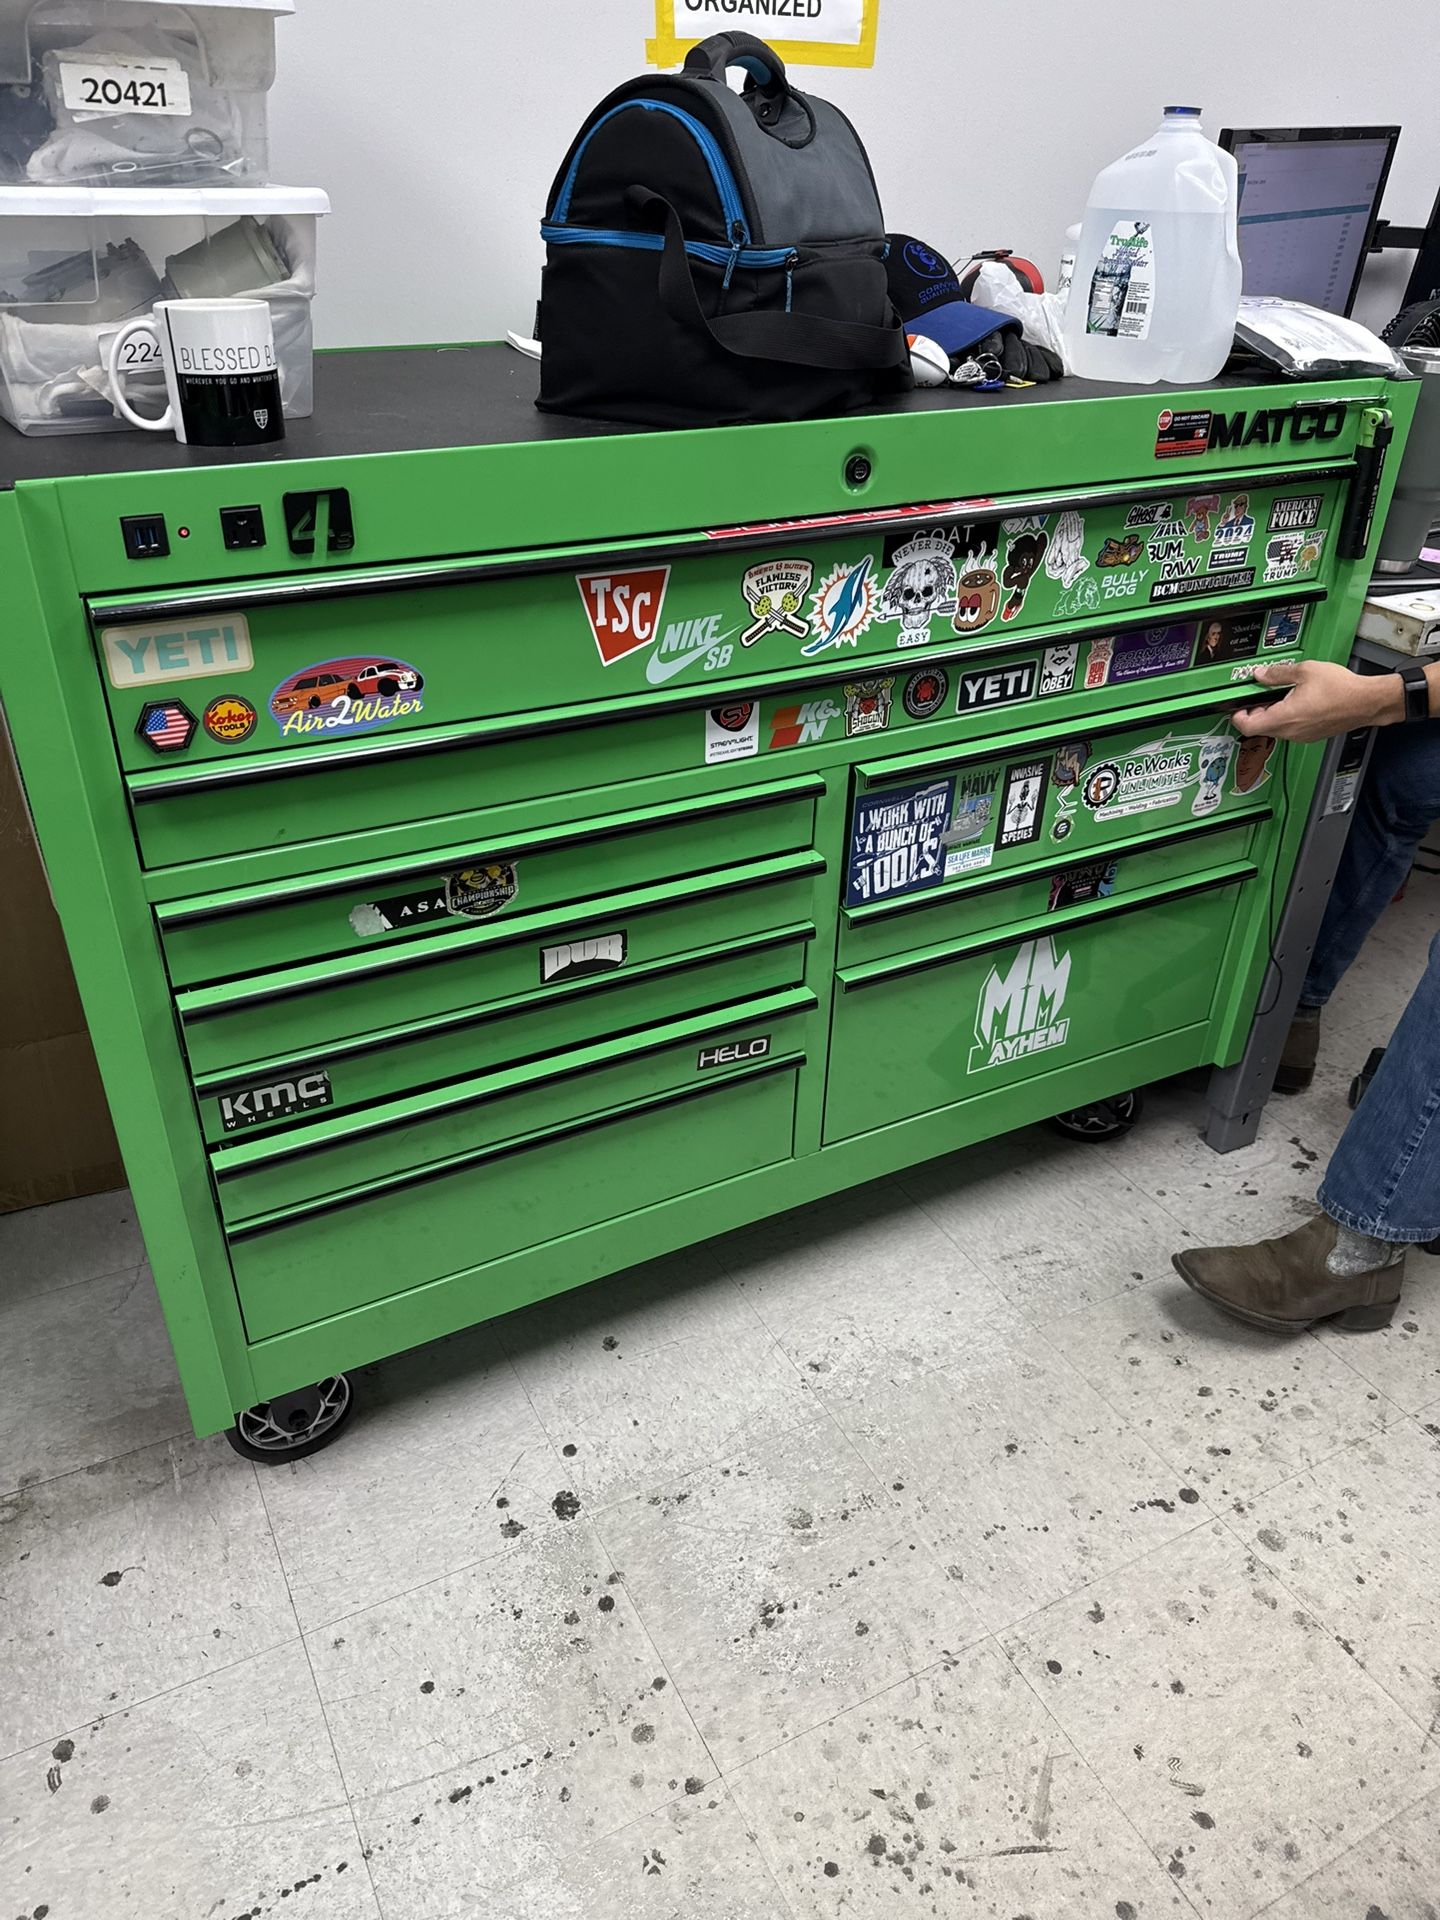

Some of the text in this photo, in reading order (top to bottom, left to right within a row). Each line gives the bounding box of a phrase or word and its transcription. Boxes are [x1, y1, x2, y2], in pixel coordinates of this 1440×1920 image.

[685, 0, 822, 18] ORGANIZED
[81, 77, 168, 107] 20421
[181, 347, 260, 371] BLESSED
[186, 377, 212, 385] WHEREVER
[216, 377, 227, 385] YOU
[230, 377, 237, 385] GO
[240, 376, 250, 384] AND
[1208, 404, 1348, 449] MATCO
[1125, 503, 1167, 527] GHOST
[1275, 499, 1319, 513] AMERICAN
[1270, 509, 1316, 528] FORCE
[1215, 525, 1252, 540] 2024
[894, 540, 952, 562] NEVER DIE
[1214, 551, 1245, 560] TRUMP
[1161, 558, 1201, 578] RAW
[1264, 568, 1298, 580] TRUMP
[756, 572, 801, 587] FLAWLESS
[759, 582, 797, 594] VICTORY
[1101, 570, 1149, 588] BULLY
[1104, 584, 1137, 599] DOG
[590, 578, 651, 640] TSC
[660, 614, 723, 654] NIKE
[900, 632, 928, 646] EASY
[114, 626, 238, 675] YETI
[704, 644, 734, 671] SB
[1115, 641, 1189, 662] CORNWELL
[965, 668, 1030, 704] YETI
[1042, 673, 1072, 692] OBEY
[218, 721, 245, 732] TOOLS
[853, 713, 882, 729] SHOGUN
[1010, 764, 1044, 781] INVASIVE
[1124, 750, 1191, 778] ReWorks
[961, 773, 1000, 798] NAVY
[1120, 771, 1187, 794] UNLIMITED
[859, 792, 947, 834] I WORK WITH
[865, 821, 936, 853] A BUNCH OF
[1001, 828, 1033, 844] SPECIES
[857, 837, 938, 898] TOOLS
[948, 853, 958, 864] SEA
[959, 850, 970, 862] LIFE
[452, 884, 515, 908] CHAMPIONSHIP
[544, 934, 623, 981] DUB
[700, 1038, 768, 1067] HELO
[227, 1097, 327, 1128] WHEELS
